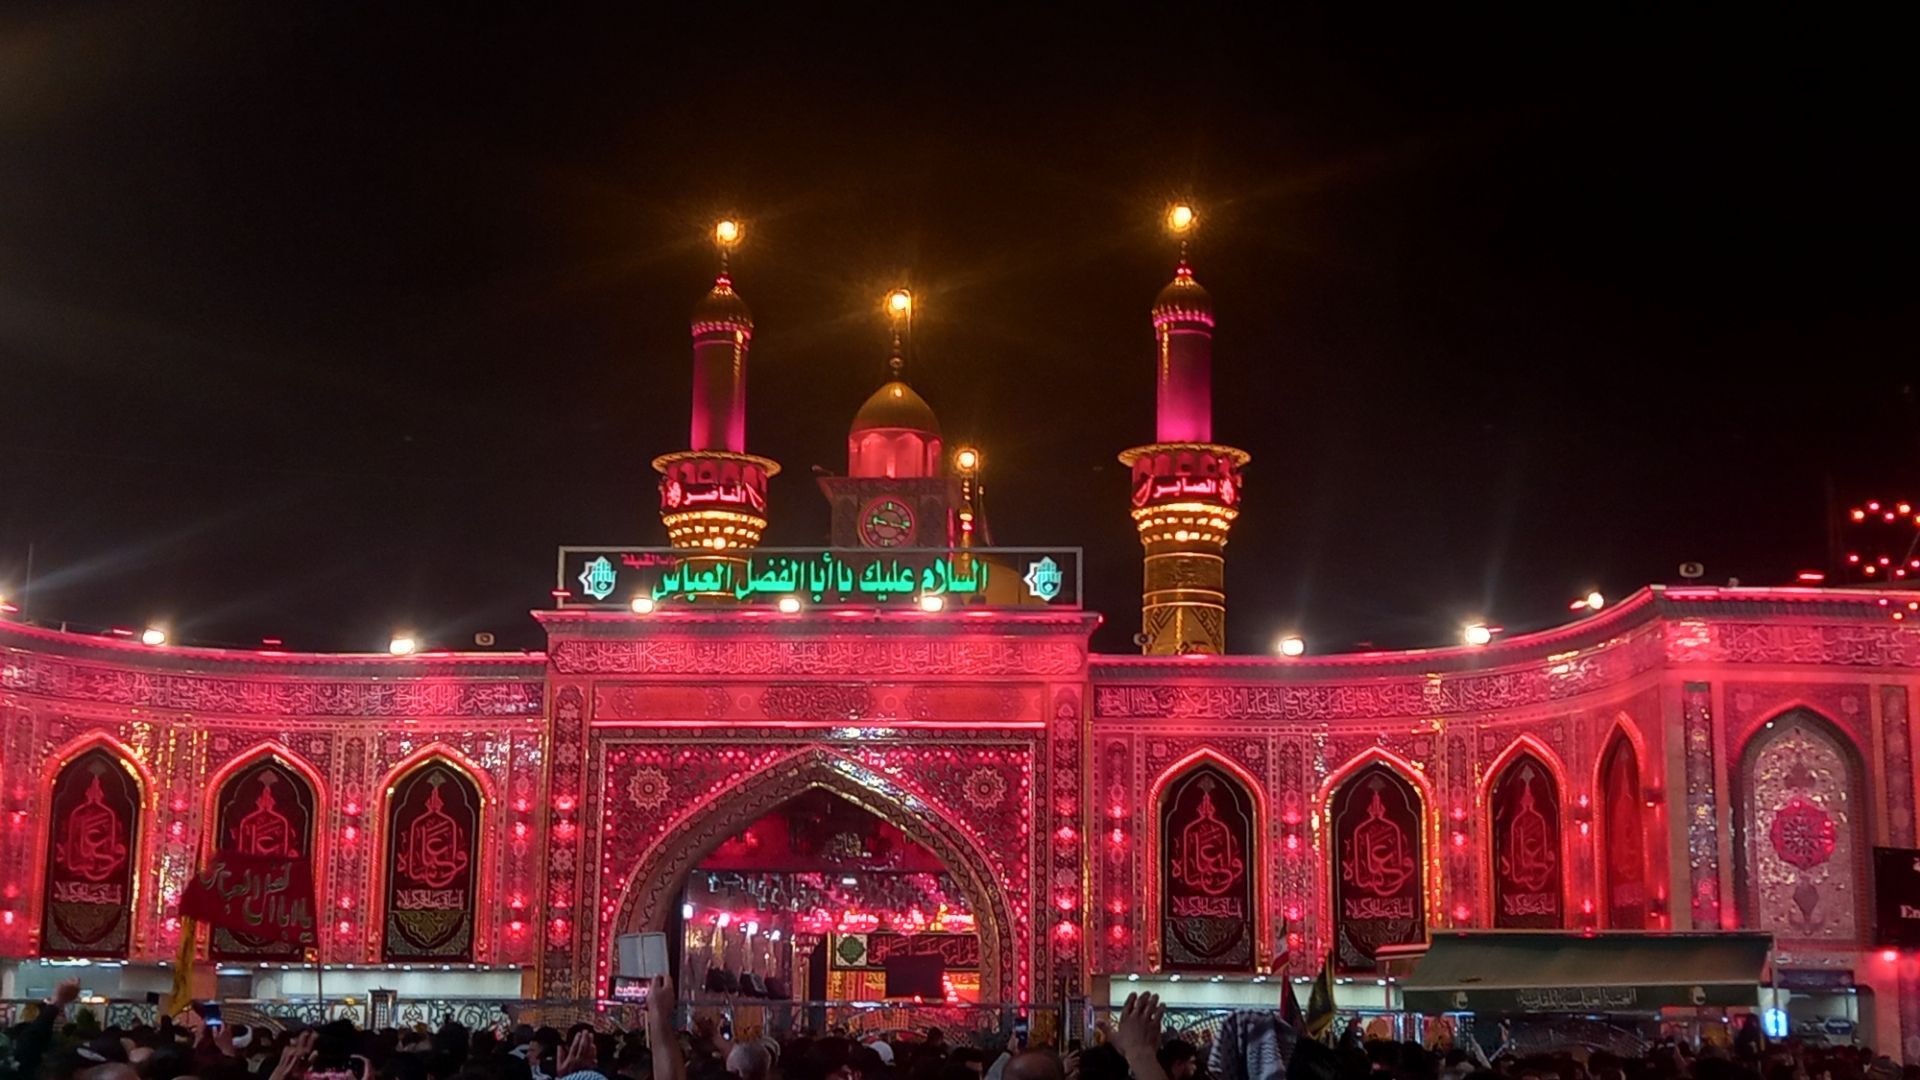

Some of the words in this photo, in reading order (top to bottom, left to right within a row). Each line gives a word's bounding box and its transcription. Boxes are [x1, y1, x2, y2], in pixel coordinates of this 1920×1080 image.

[682, 481, 746, 506] الناصر
[1152, 477, 1217, 499] الصابر
[651, 561, 732, 603] العباس
[735, 557, 805, 601] الفضل
[859, 559, 915, 602] عليك
[920, 555, 989, 597] السلام
